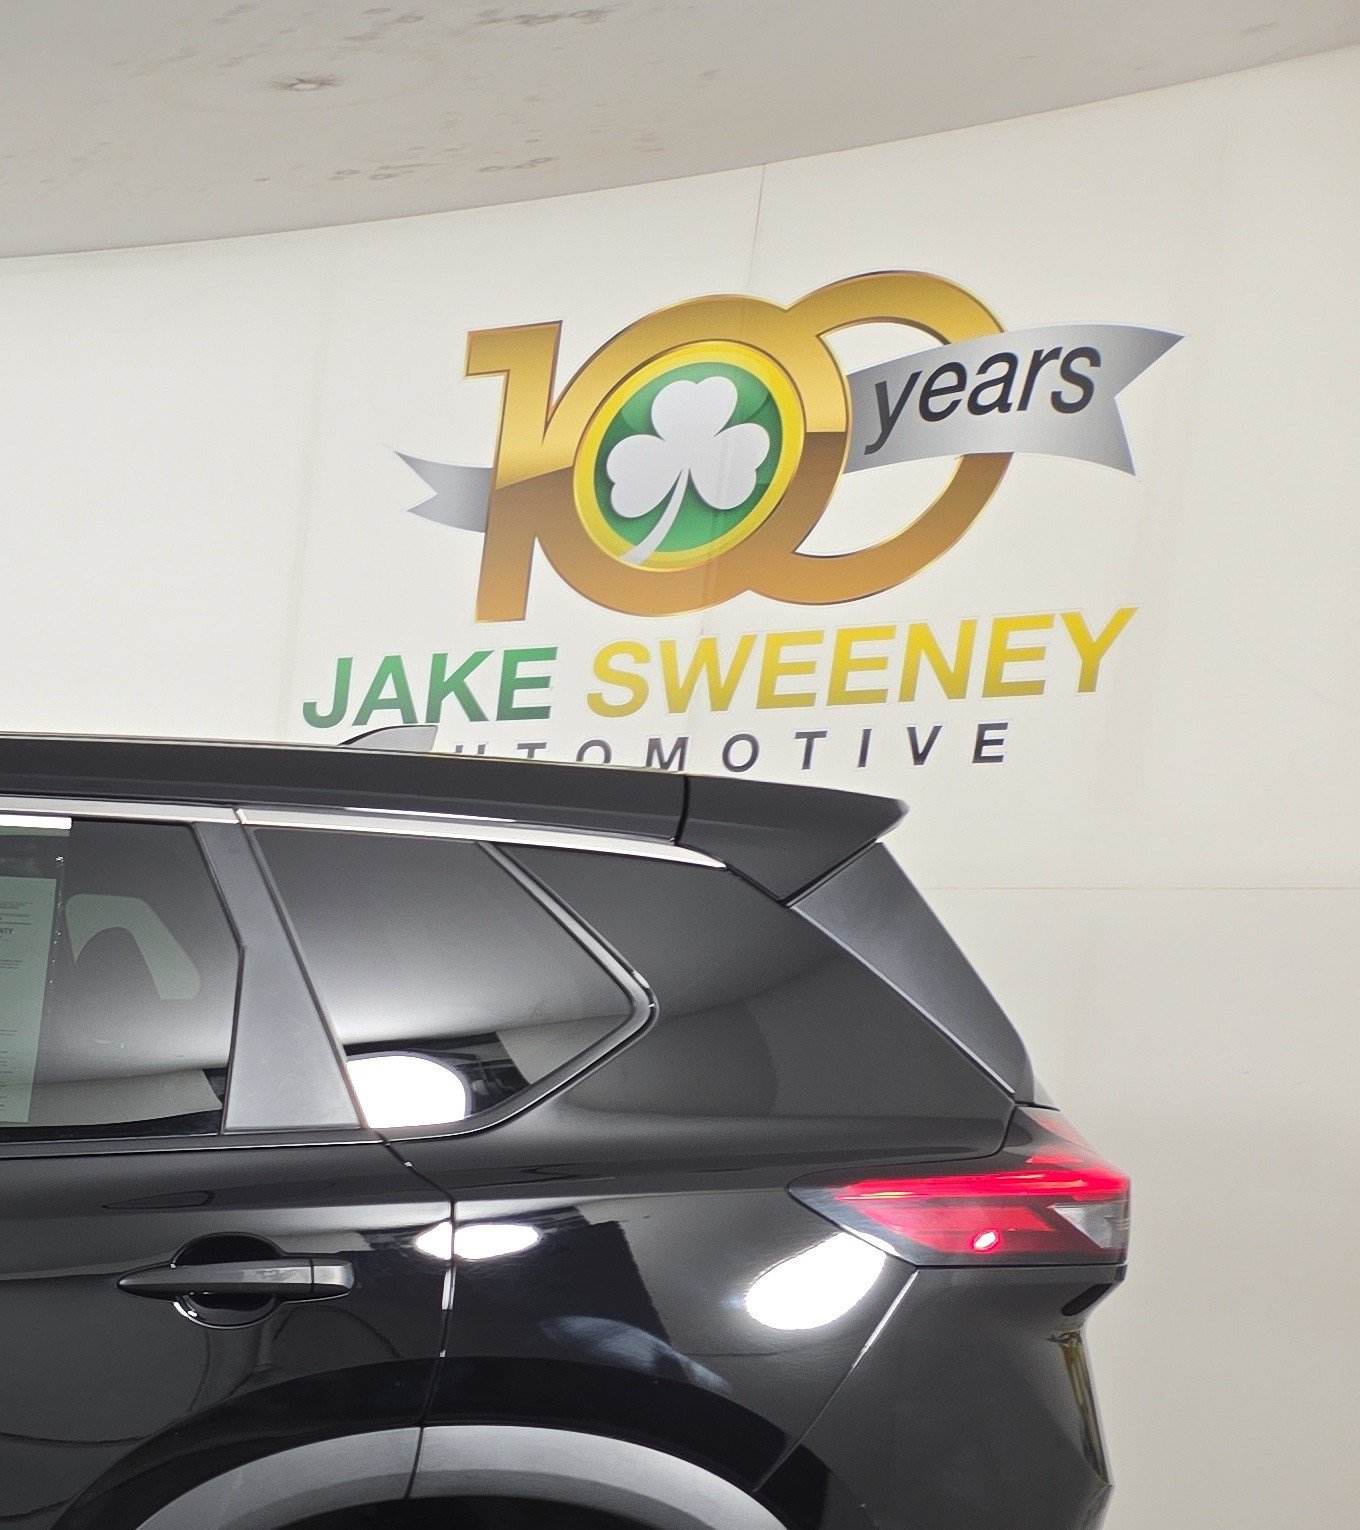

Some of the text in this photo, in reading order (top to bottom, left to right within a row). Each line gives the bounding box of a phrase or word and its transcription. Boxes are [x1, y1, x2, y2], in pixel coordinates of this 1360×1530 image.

[864, 342, 1101, 456] years
[302, 607, 1138, 729] JAKE SWEENEY
